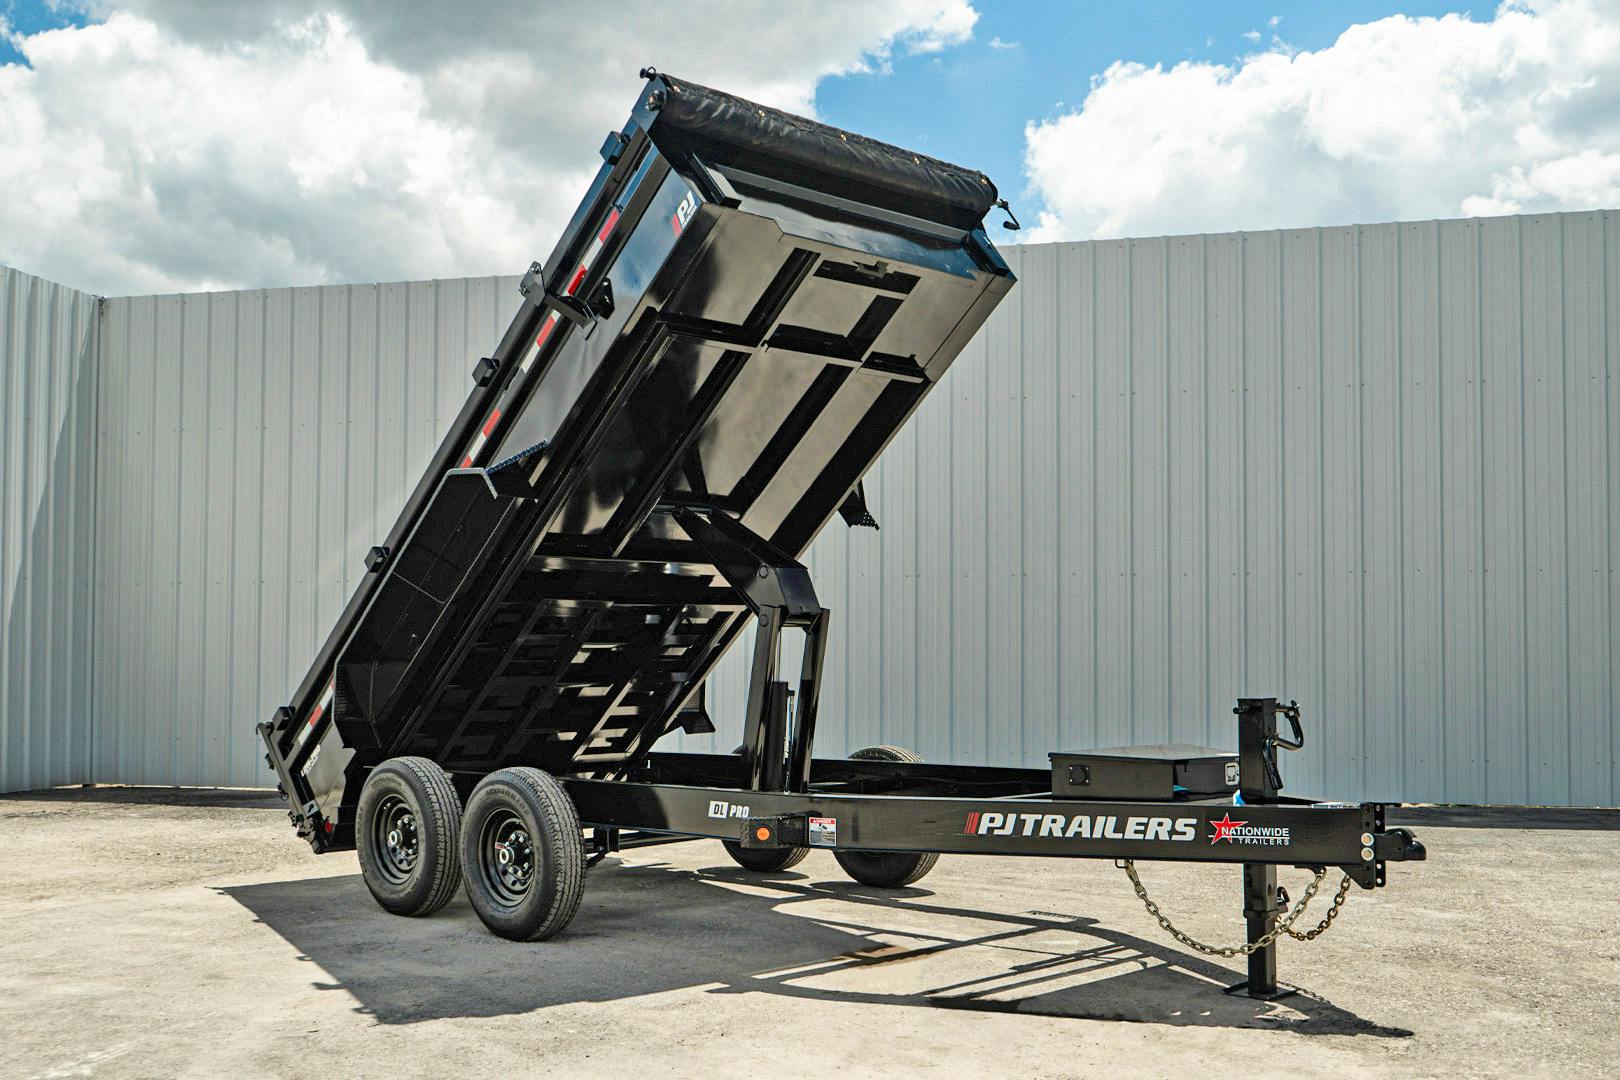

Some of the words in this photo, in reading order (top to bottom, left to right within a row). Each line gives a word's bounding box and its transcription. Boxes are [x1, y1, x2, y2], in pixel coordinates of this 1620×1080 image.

[677, 190, 695, 225] PJ
[729, 804, 750, 818] PRO
[1221, 826, 1290, 837] NATIONWIDE
[1239, 837, 1290, 846] TRAILERS
